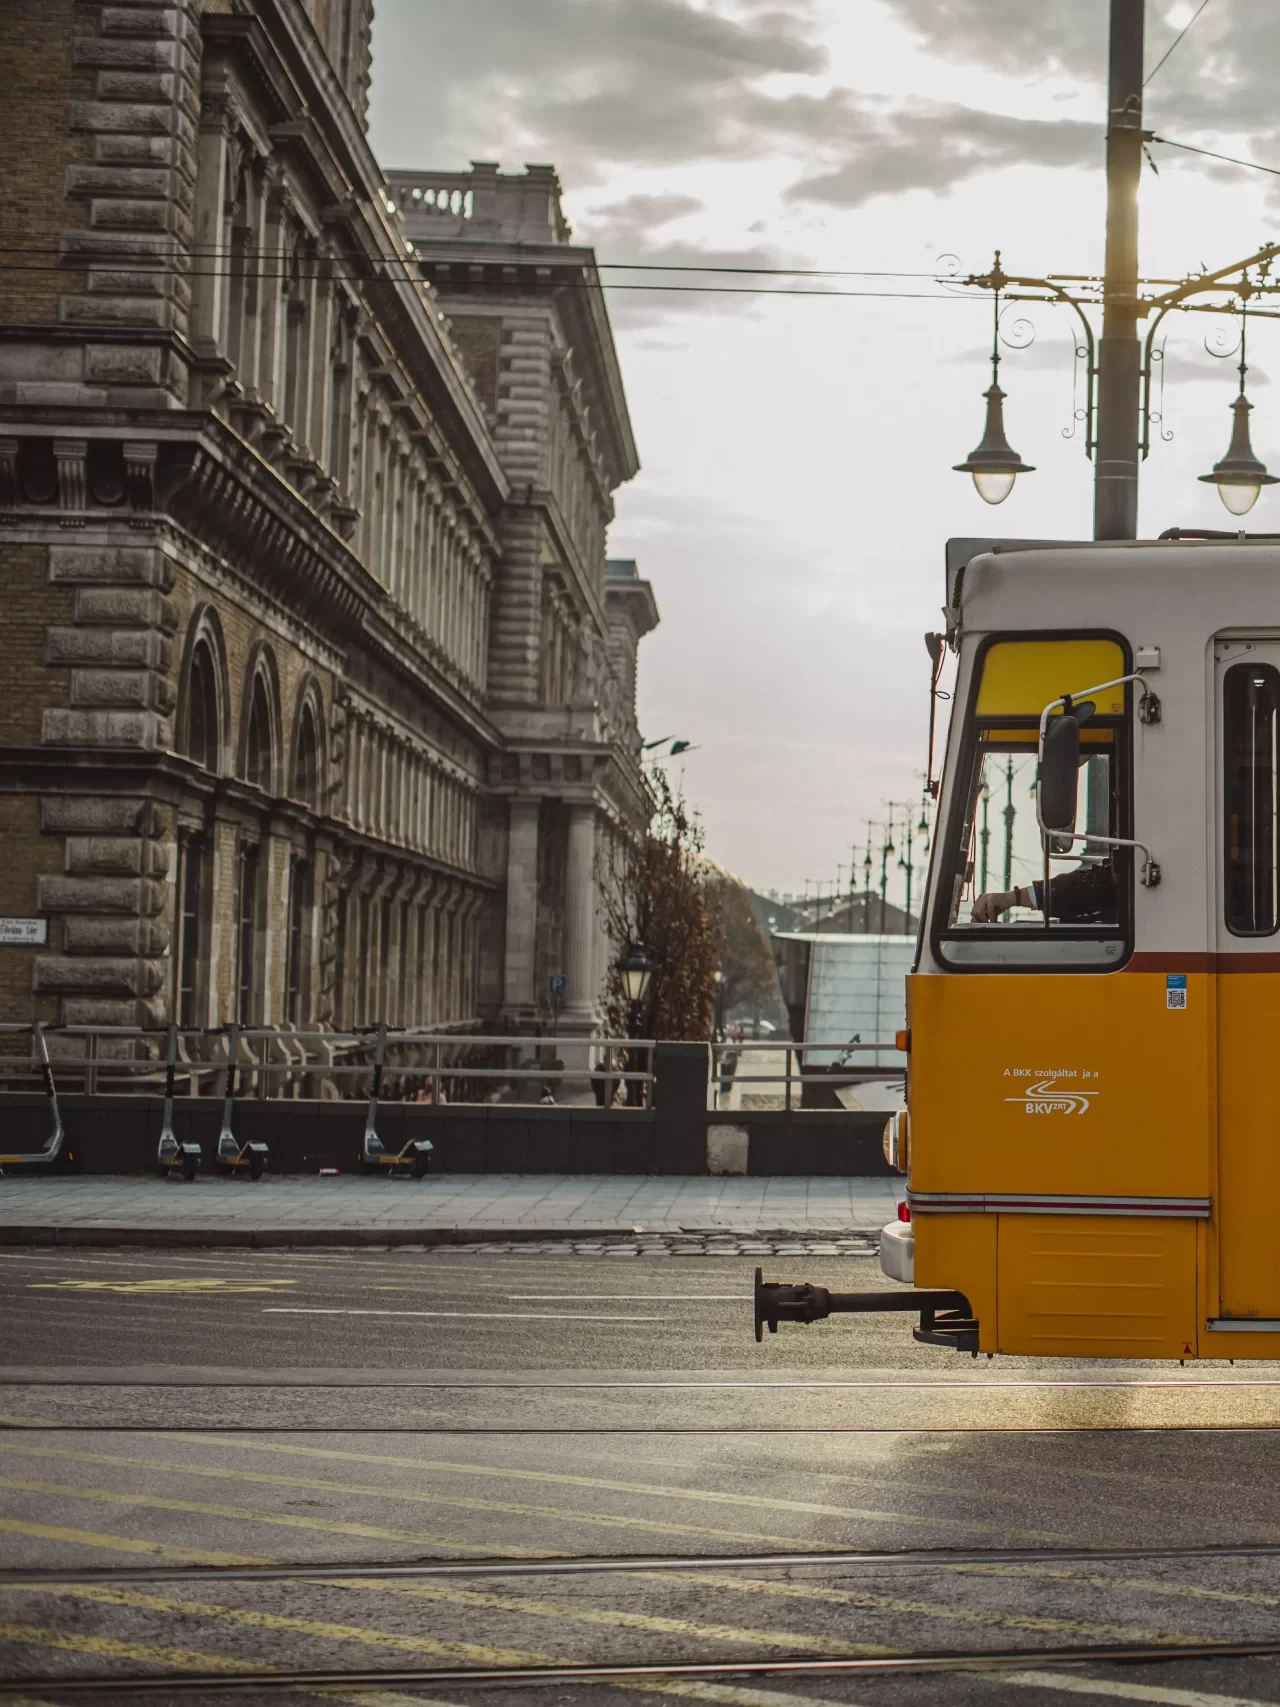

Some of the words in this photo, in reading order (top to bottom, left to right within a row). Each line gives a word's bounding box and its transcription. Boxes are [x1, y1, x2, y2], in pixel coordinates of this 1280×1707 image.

[1003, 1068, 1011, 1077] A
[1013, 1068, 1032, 1077] BKK
[1034, 1068, 1078, 1079] szolgáltat
[1082, 1069, 1091, 1079] ja
[1093, 1070, 1099, 1078] a
[1025, 1102, 1053, 1114] BKV
